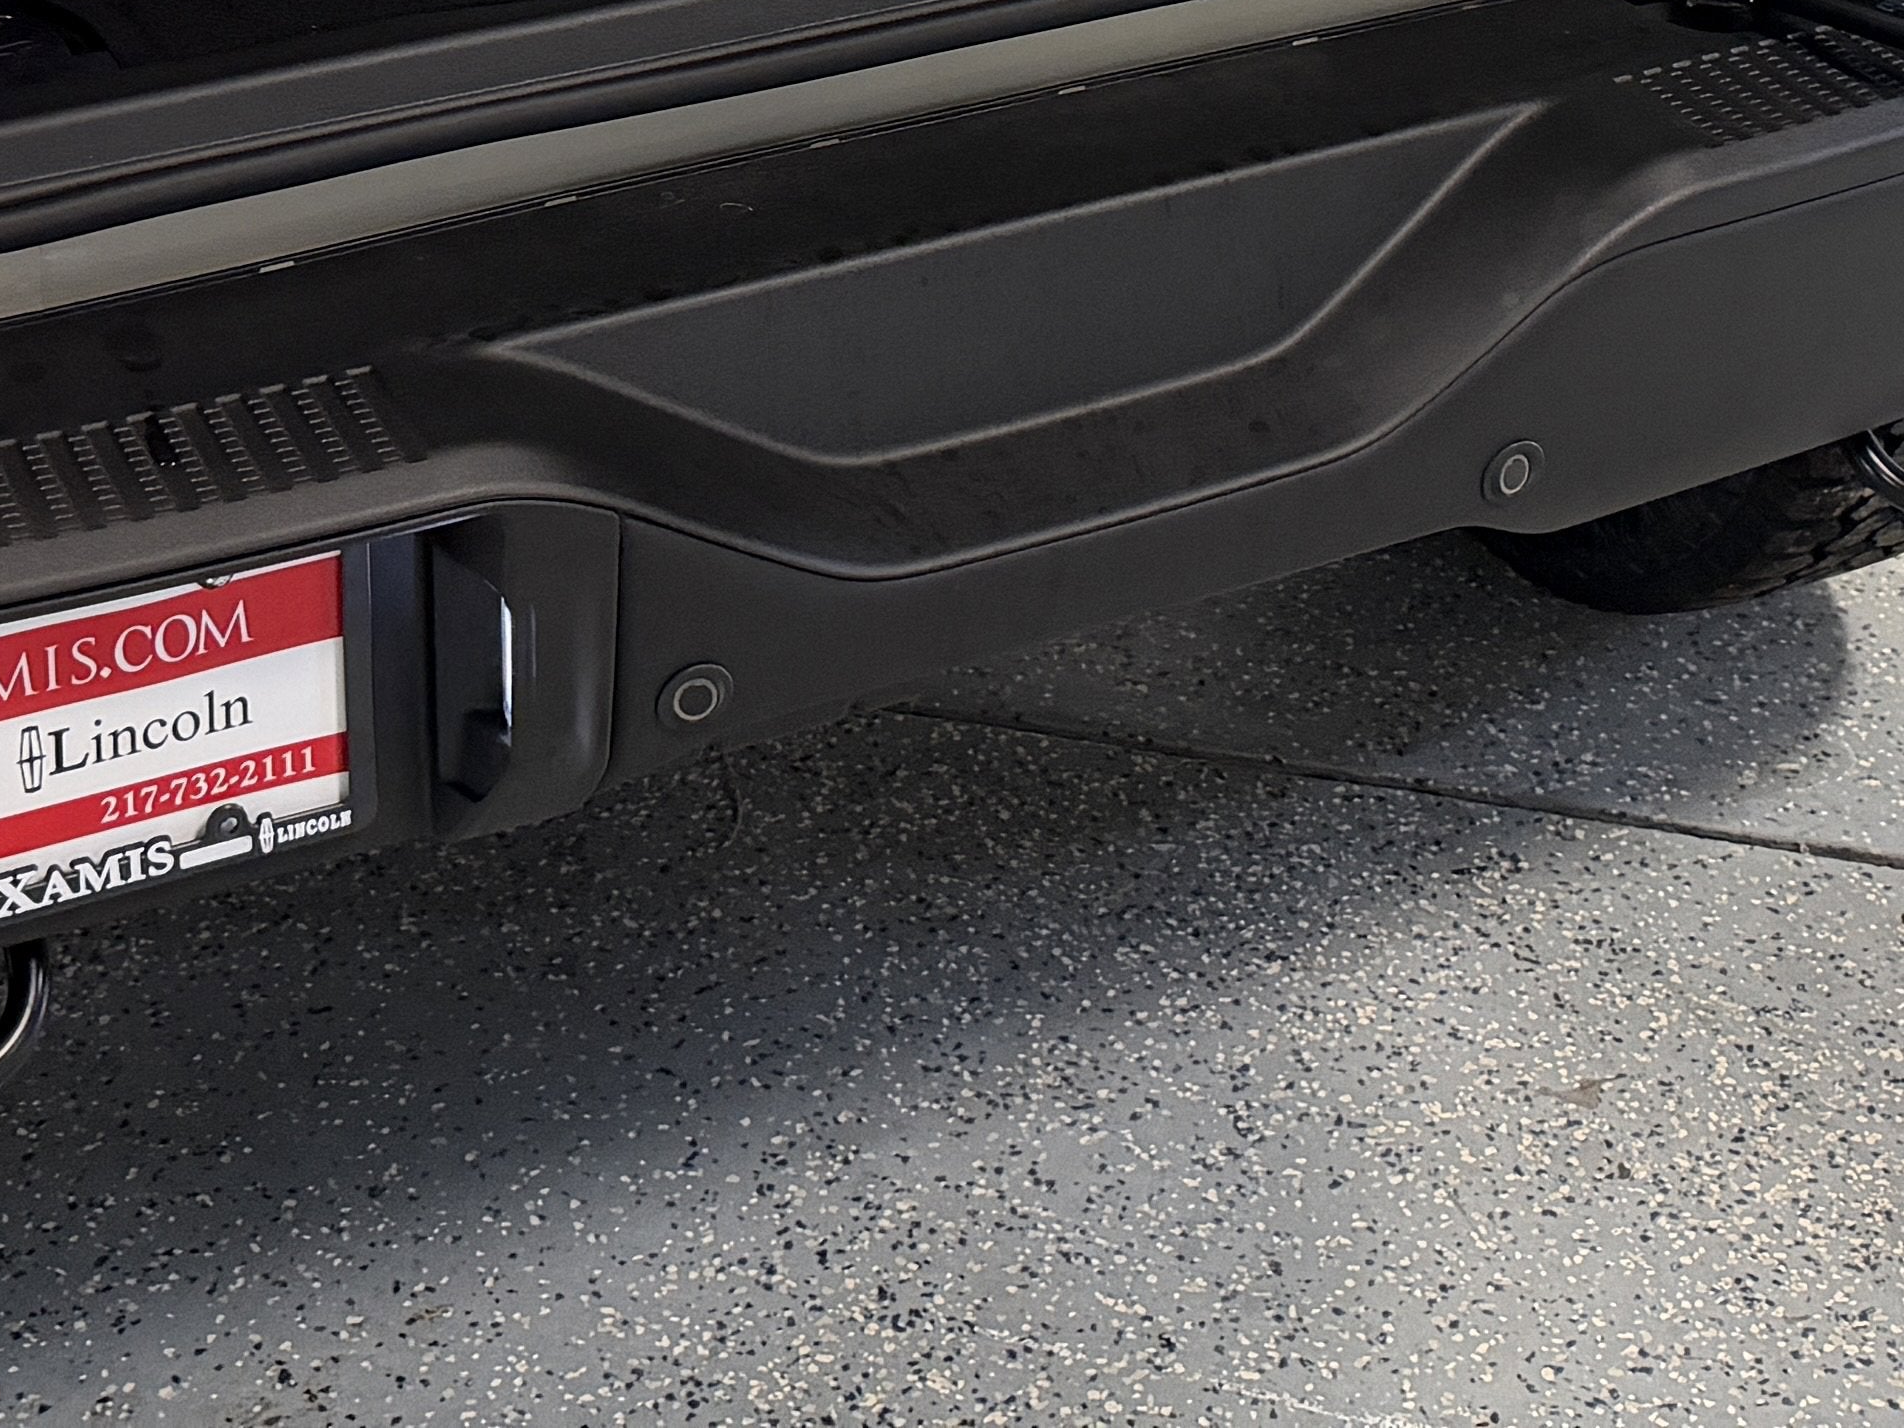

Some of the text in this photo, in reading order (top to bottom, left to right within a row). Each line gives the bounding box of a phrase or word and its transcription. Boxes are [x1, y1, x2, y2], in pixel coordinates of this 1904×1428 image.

[48, 690, 253, 776] Lincoln
[100, 746, 316, 824] 217-732-2111
[276, 810, 352, 843] LINCOLN
